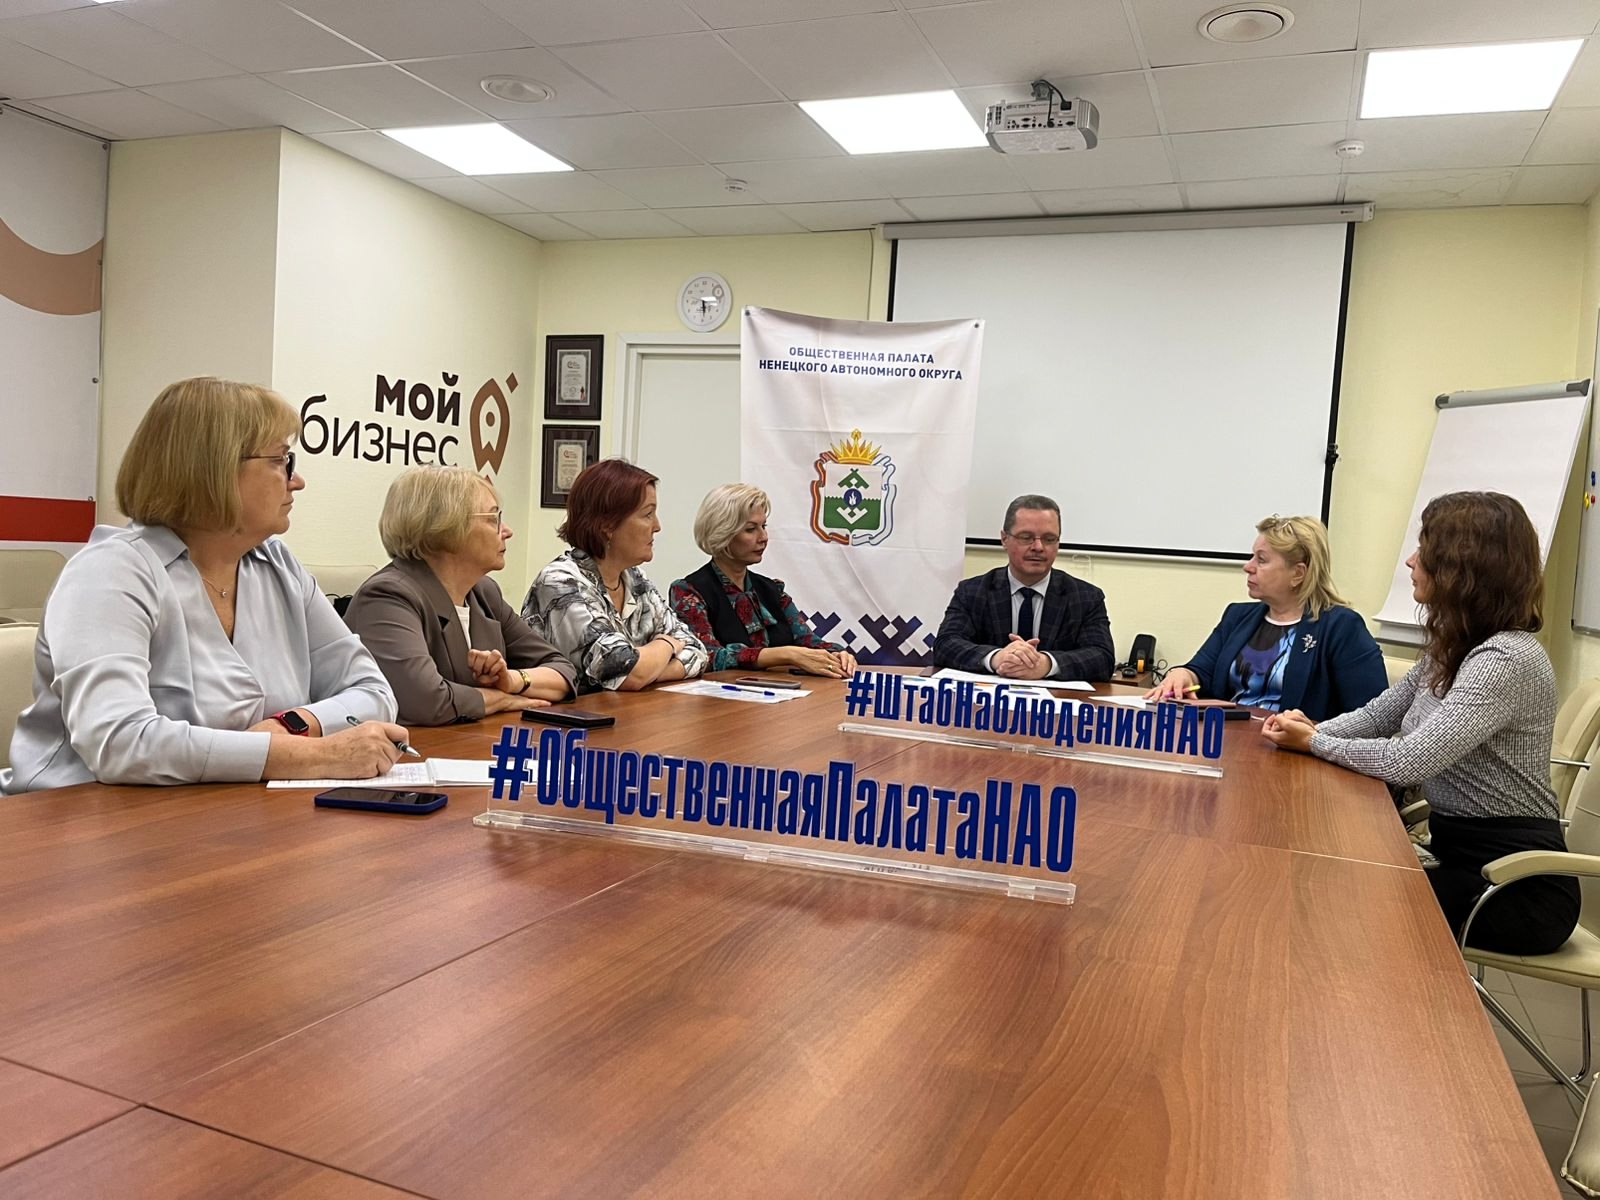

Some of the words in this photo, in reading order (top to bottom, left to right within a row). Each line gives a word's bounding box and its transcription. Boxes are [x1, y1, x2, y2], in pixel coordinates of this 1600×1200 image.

[759, 359, 828, 373] НЕНЕЦКОГО
[830, 364, 916, 378] АВТОНОМНОГО
[918, 368, 963, 380] ОКРУГА
[789, 346, 885, 362] ОБЩЕСТВЕННАЯ
[888, 353, 935, 364] ПАЛАТА
[300, 394, 459, 467] бизнес
[846, 671, 1224, 759] #ШтабНаблюденияНАО
[488, 726, 1077, 873] #ОбщественнаяПалатаНАО
